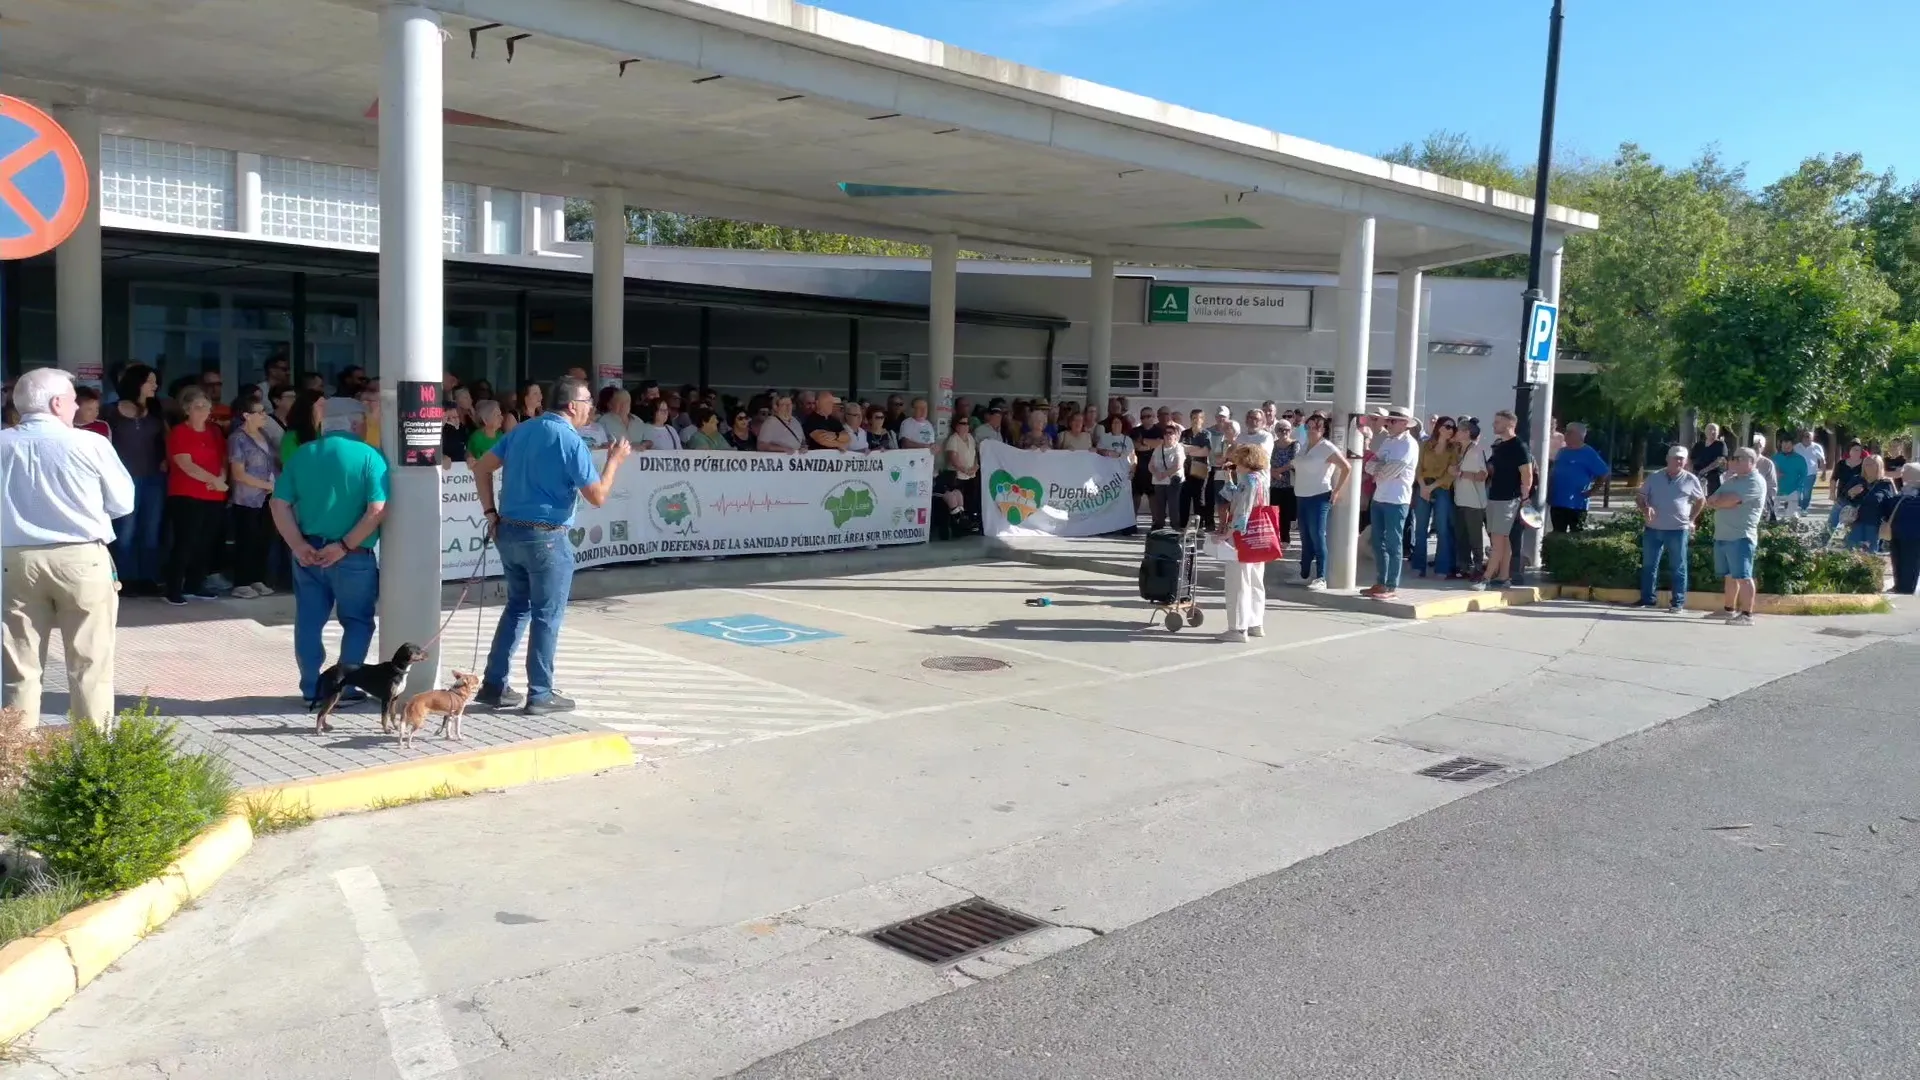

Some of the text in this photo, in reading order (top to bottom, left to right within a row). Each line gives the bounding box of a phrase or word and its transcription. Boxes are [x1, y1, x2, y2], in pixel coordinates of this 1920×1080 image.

[1194, 294, 1284, 307] Centro de Salud
[1194, 307, 1212, 316] Villa
[1214, 308, 1227, 317] del
[1229, 308, 1242, 317] Río
[1531, 308, 1552, 357] P
[420, 385, 436, 402] NO
[640, 456, 690, 472] DINERO
[694, 456, 748, 472] PÚBLICO
[750, 458, 784, 472] PARA
[789, 458, 843, 472] SANIDAD
[573, 543, 649, 563] OORDINADOR
[661, 538, 710, 552] DEFENSA
[713, 538, 726, 550] DE
[728, 537, 741, 549] LA
[743, 536, 788, 549] SANIDAD
[791, 533, 826, 548] PÚBLICA
[828, 533, 842, 545] DEL
[844, 530, 865, 544] ÁREA
[866, 530, 880, 542] SUR
[882, 530, 892, 541] DE
